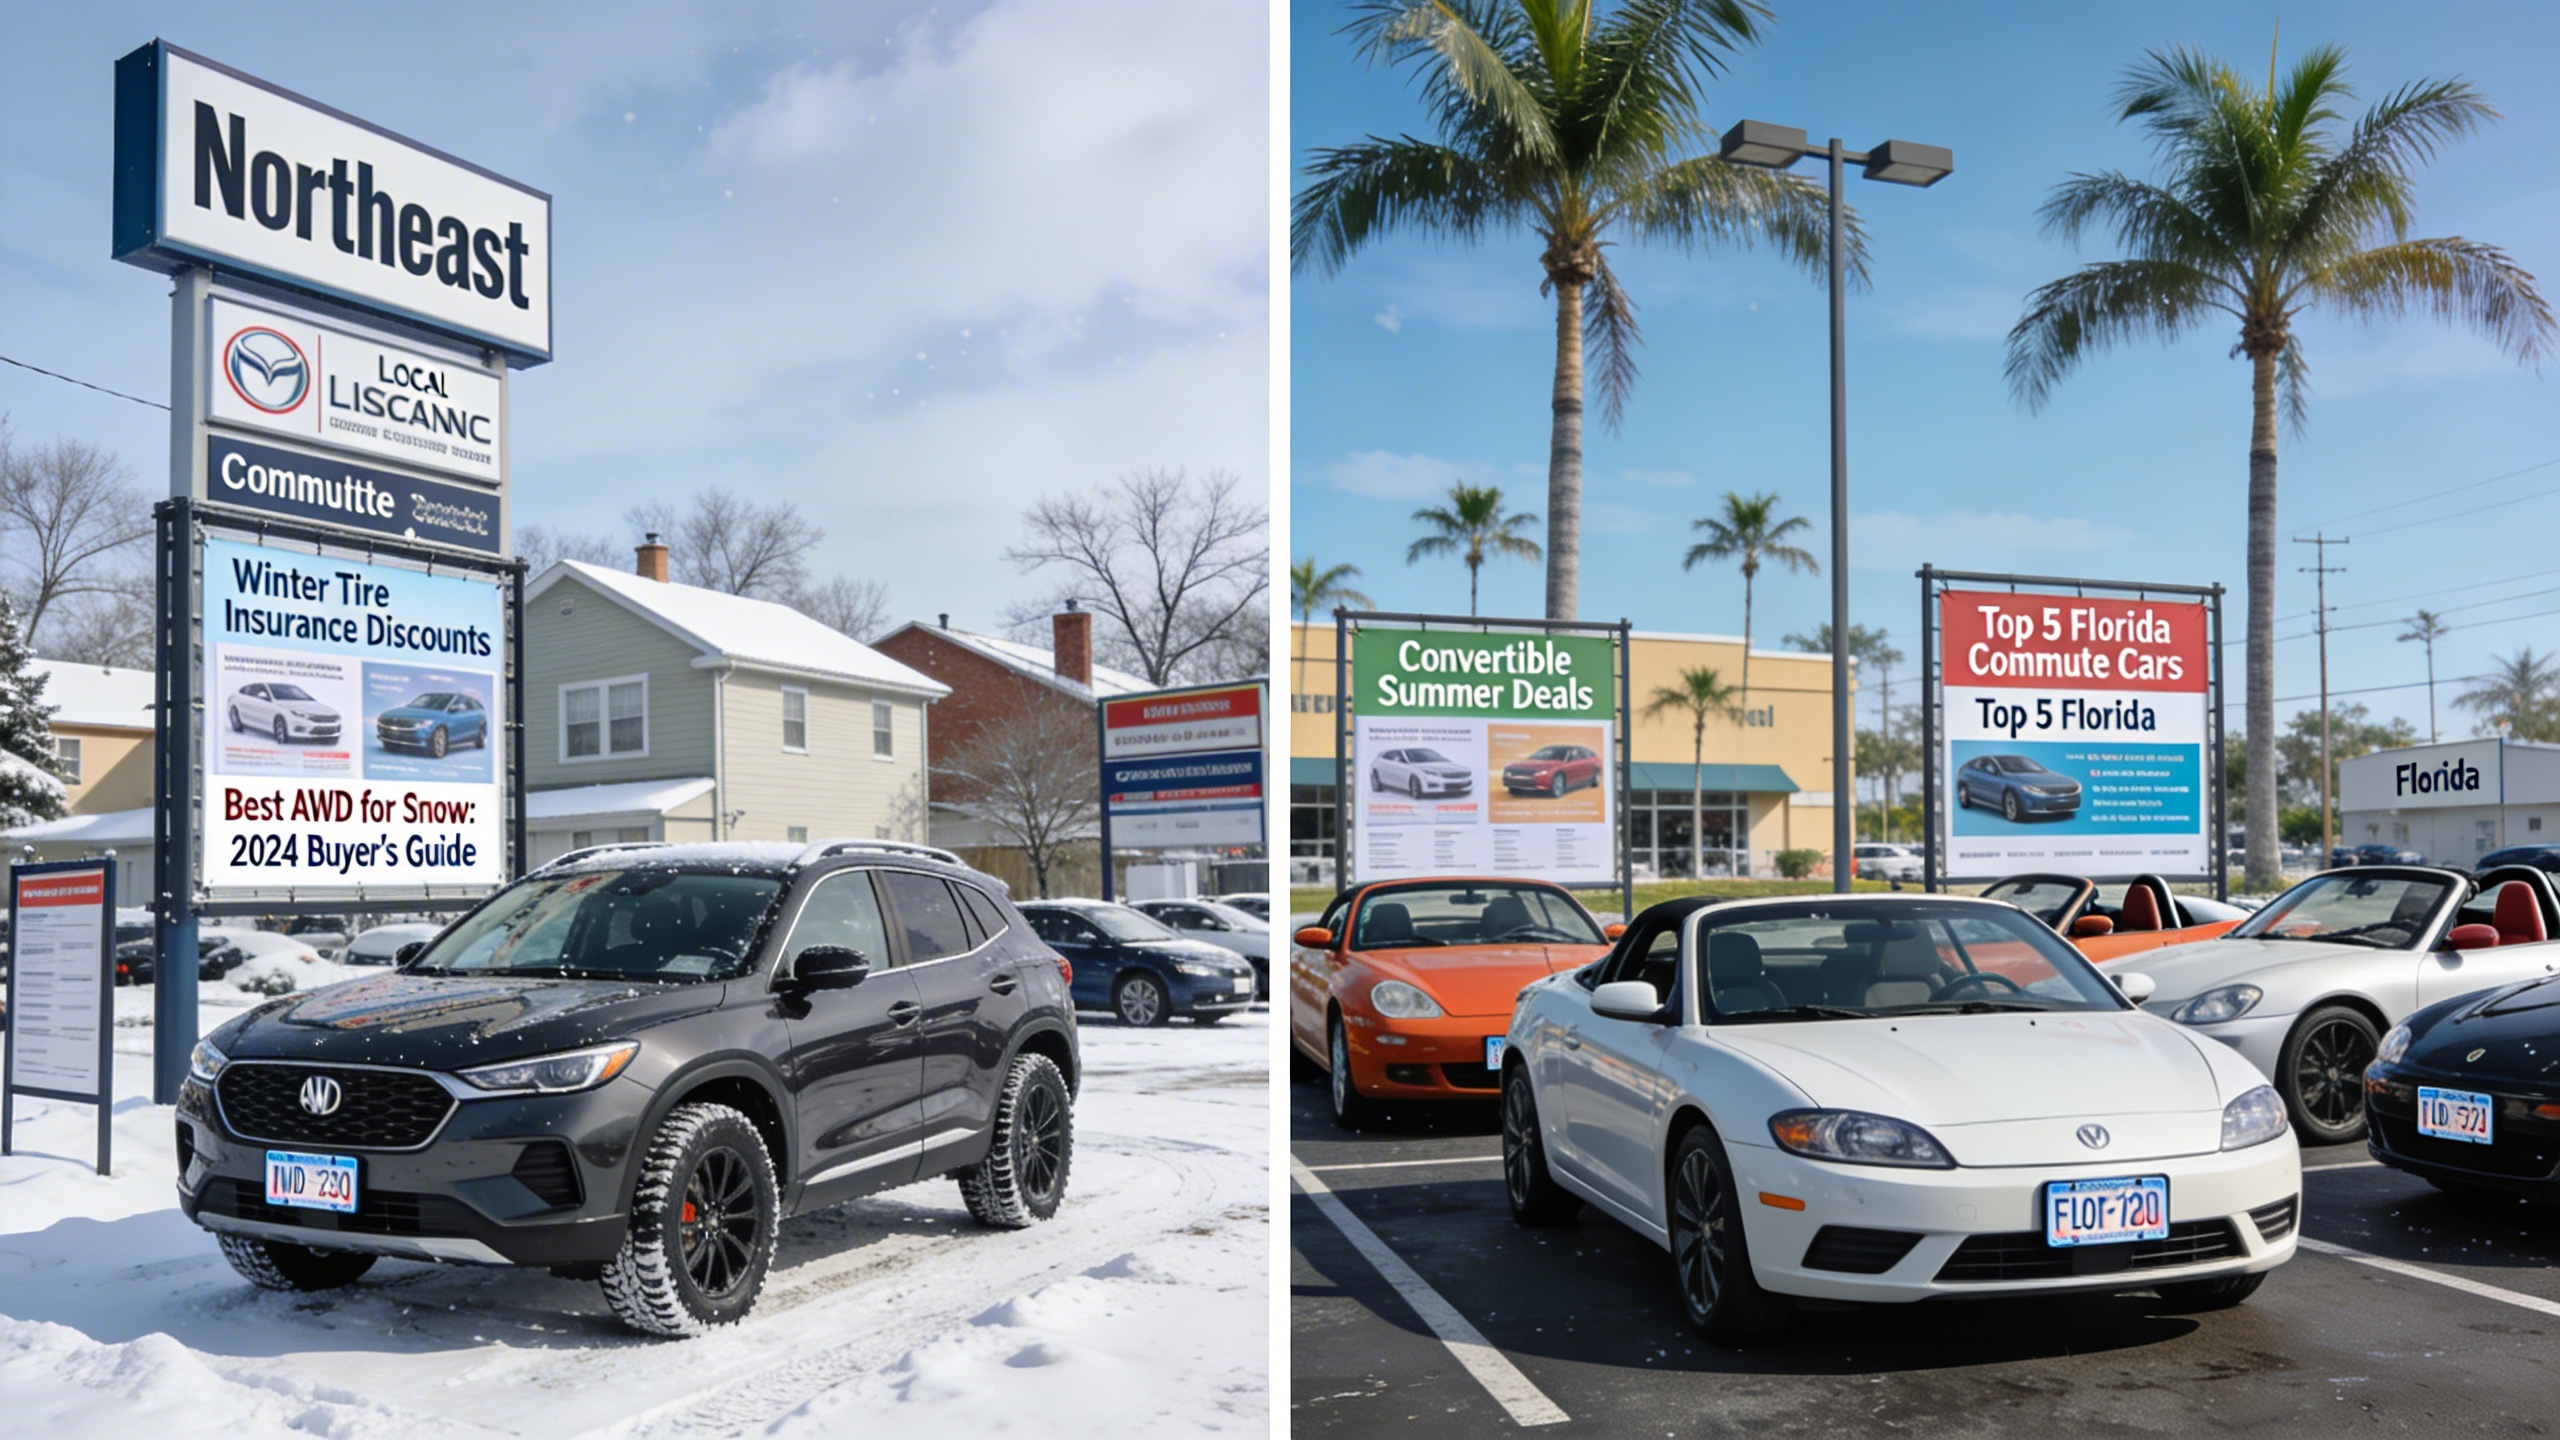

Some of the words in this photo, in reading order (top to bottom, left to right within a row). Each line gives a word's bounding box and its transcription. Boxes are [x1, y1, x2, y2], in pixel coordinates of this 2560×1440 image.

[194, 99, 530, 310] Northeast
[379, 354, 449, 399] LOCAL
[232, 558, 330, 602] Winter
[335, 572, 390, 608] Tire
[224, 599, 358, 645] Insurance
[367, 614, 492, 657] Discounts
[1978, 605, 2034, 648] Top
[2042, 607, 2062, 641] 5
[2071, 607, 2171, 644] Florida
[1399, 640, 1572, 675] Convertible
[1968, 642, 2110, 678] Commute
[2117, 647, 2183, 680] Cars
[1378, 674, 1504, 708] Summer
[1512, 677, 1594, 710] Deals
[1975, 698, 2027, 739] Top
[2036, 698, 2052, 729] 5
[2062, 698, 2156, 731] Florida
[2396, 758, 2480, 796] Florida
[224, 788, 285, 821] Best
[290, 789, 353, 822] AWD
[361, 789, 396, 823] for
[403, 792, 476, 824] Snow:
[230, 833, 299, 867] 2024
[307, 833, 399, 875] Buyer's
[405, 833, 477, 867] Guide
